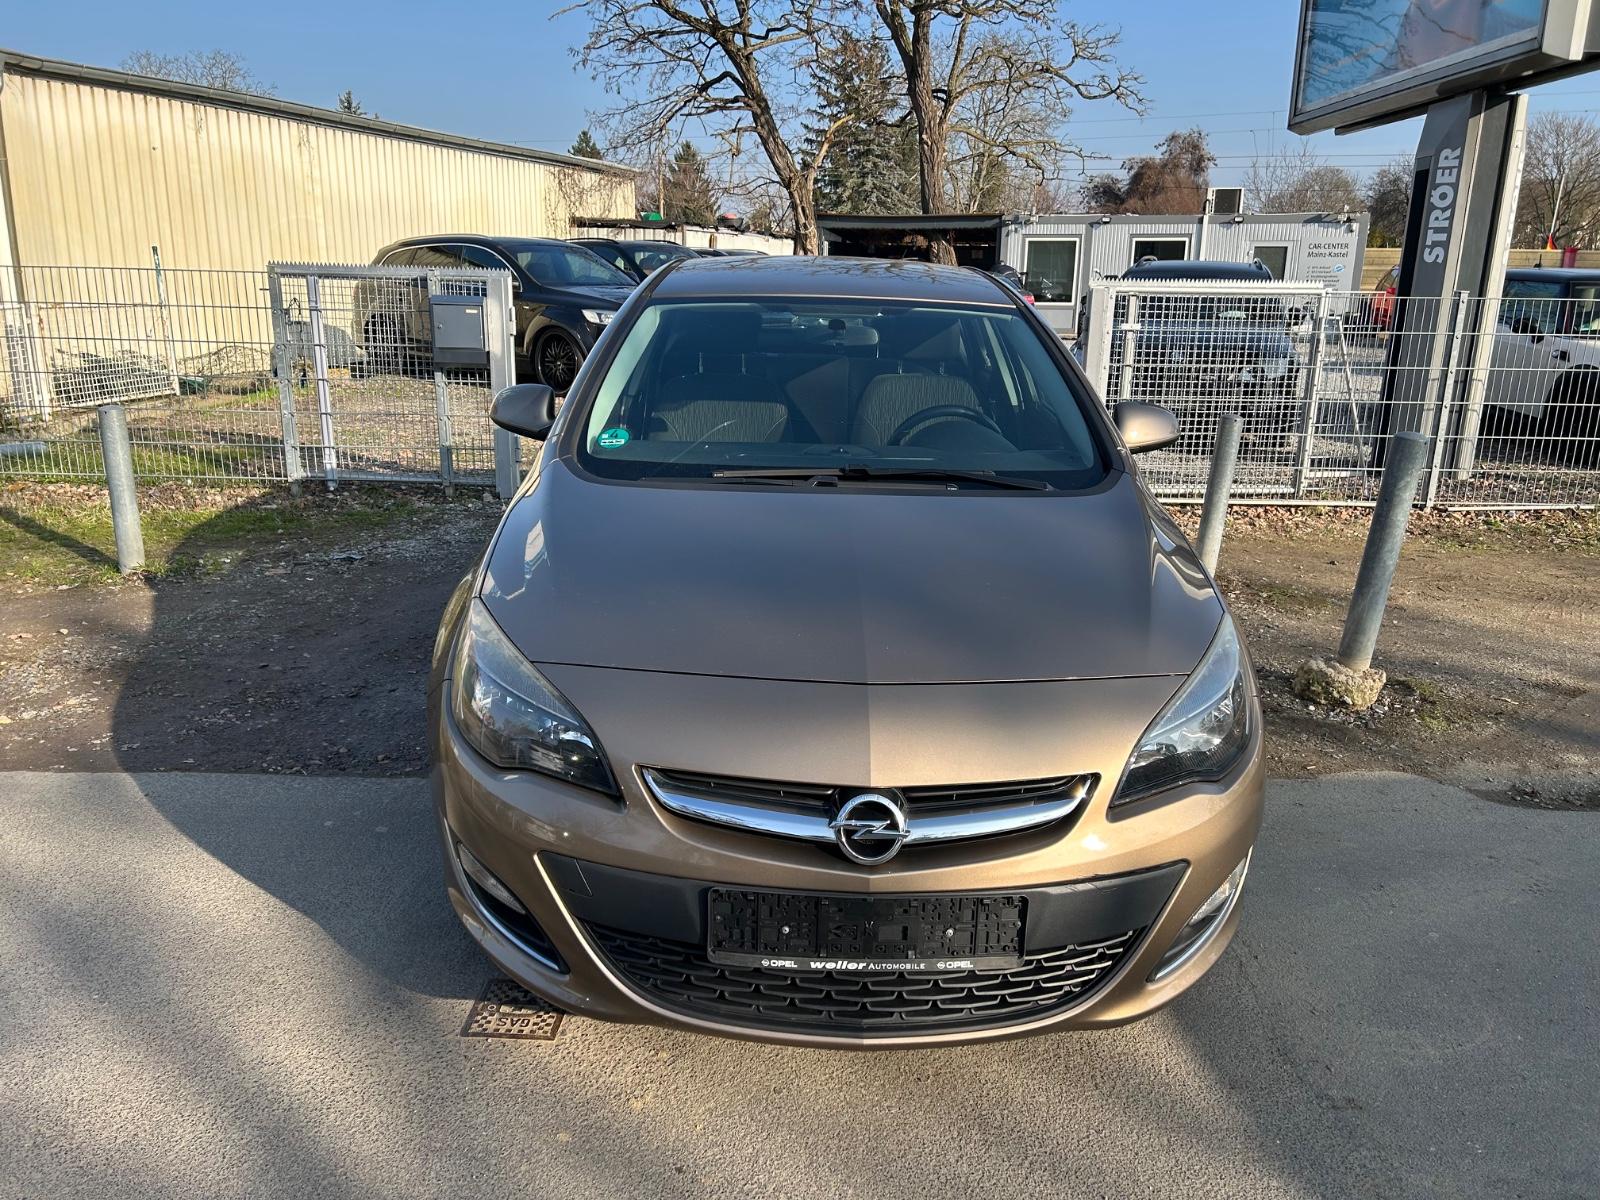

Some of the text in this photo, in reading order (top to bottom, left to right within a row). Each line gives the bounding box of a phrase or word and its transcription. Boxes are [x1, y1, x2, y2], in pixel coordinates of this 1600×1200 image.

[1423, 147, 1461, 264] STRÖER
[770, 959, 798, 968] OPEL
[810, 960, 867, 970] weller
[945, 960, 974, 969] OPEL
[497, 1018, 531, 1028] GAS
